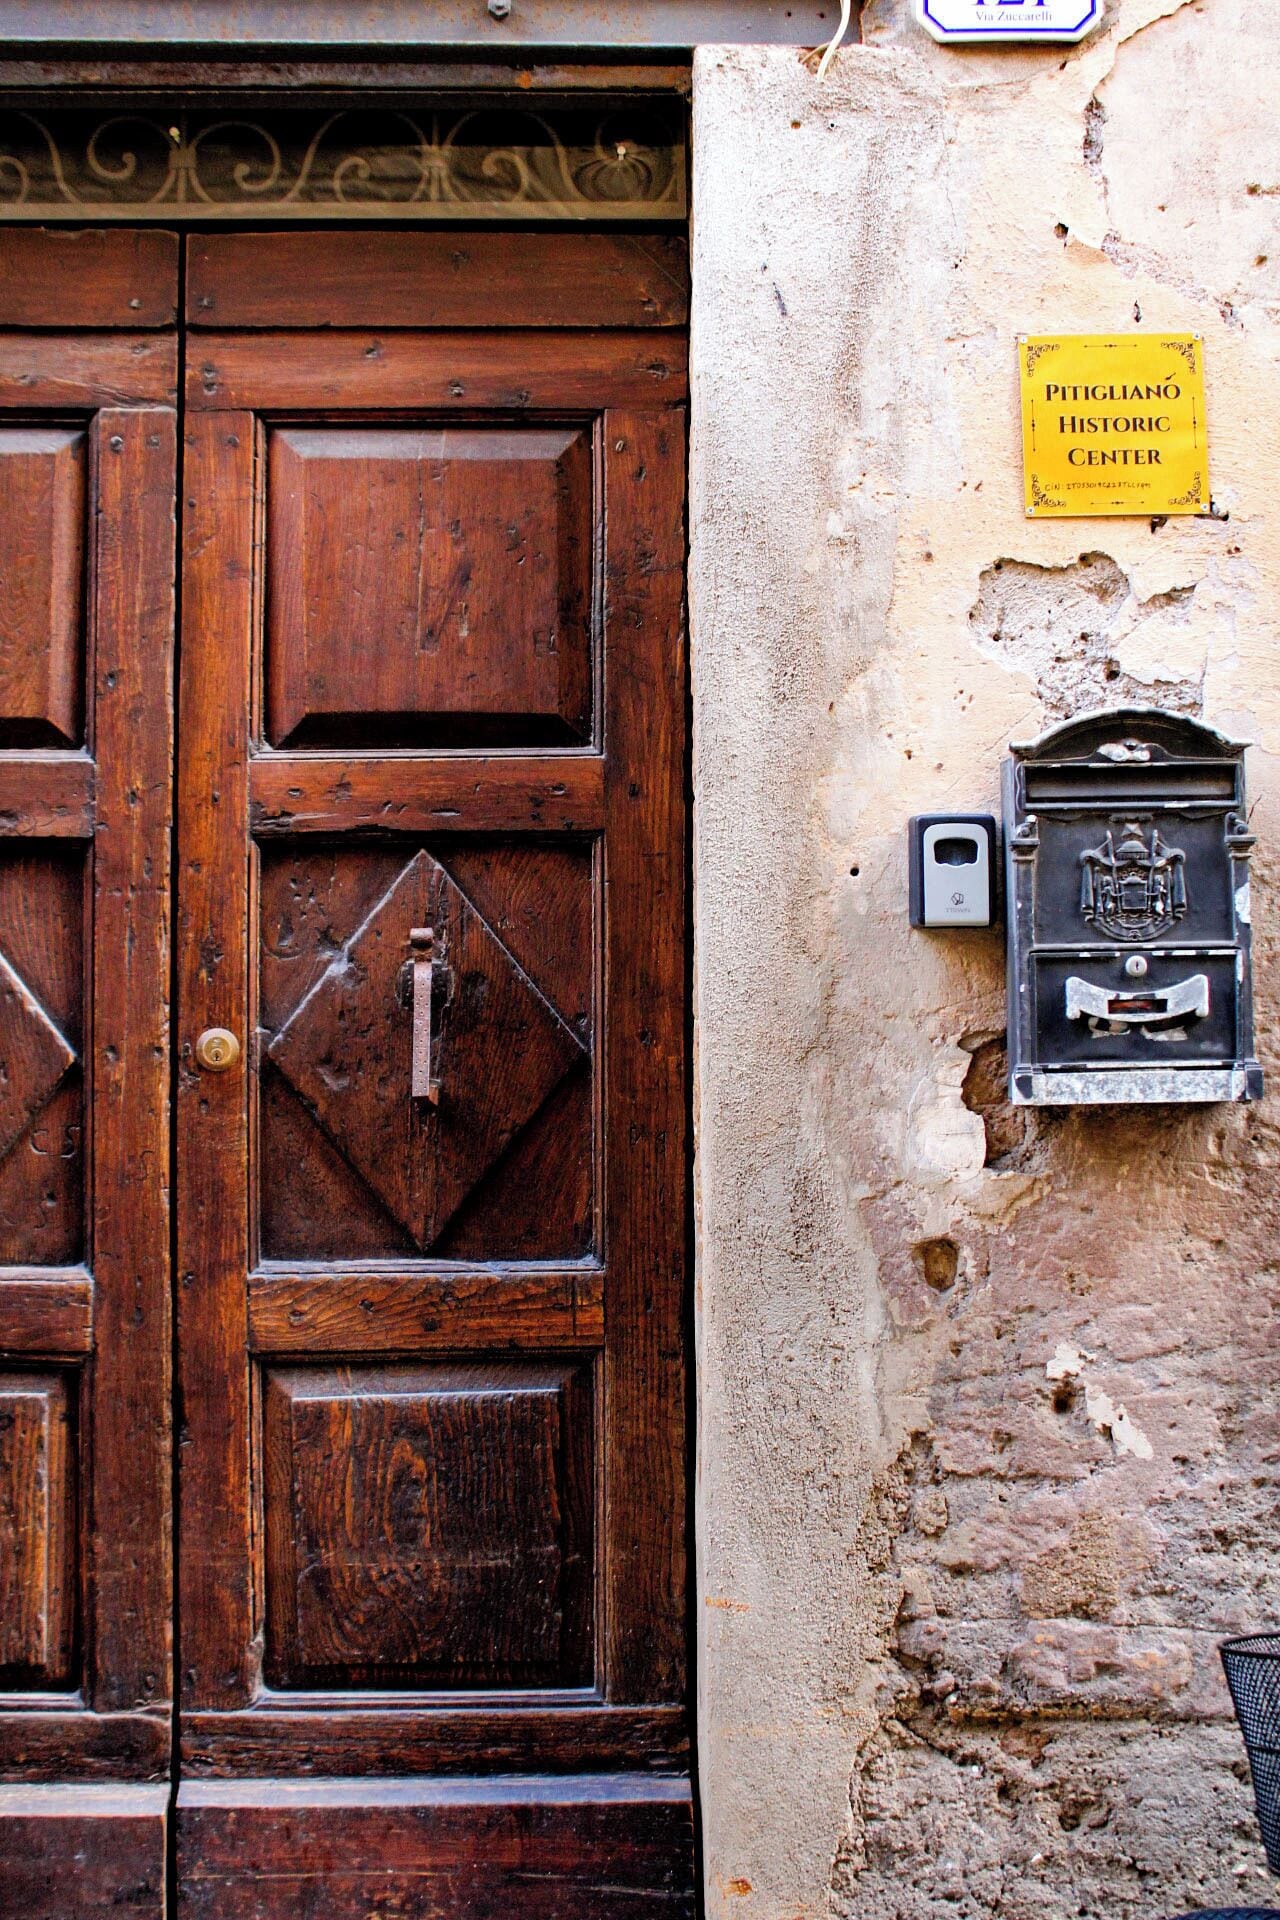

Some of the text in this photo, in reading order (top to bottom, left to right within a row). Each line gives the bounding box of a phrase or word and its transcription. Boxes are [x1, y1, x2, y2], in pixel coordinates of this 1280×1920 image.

[976, 11, 1053, 21] Via Zuccarelli
[1059, 416, 1171, 433] HISTORIC
[1067, 448, 1162, 466] CENTER
